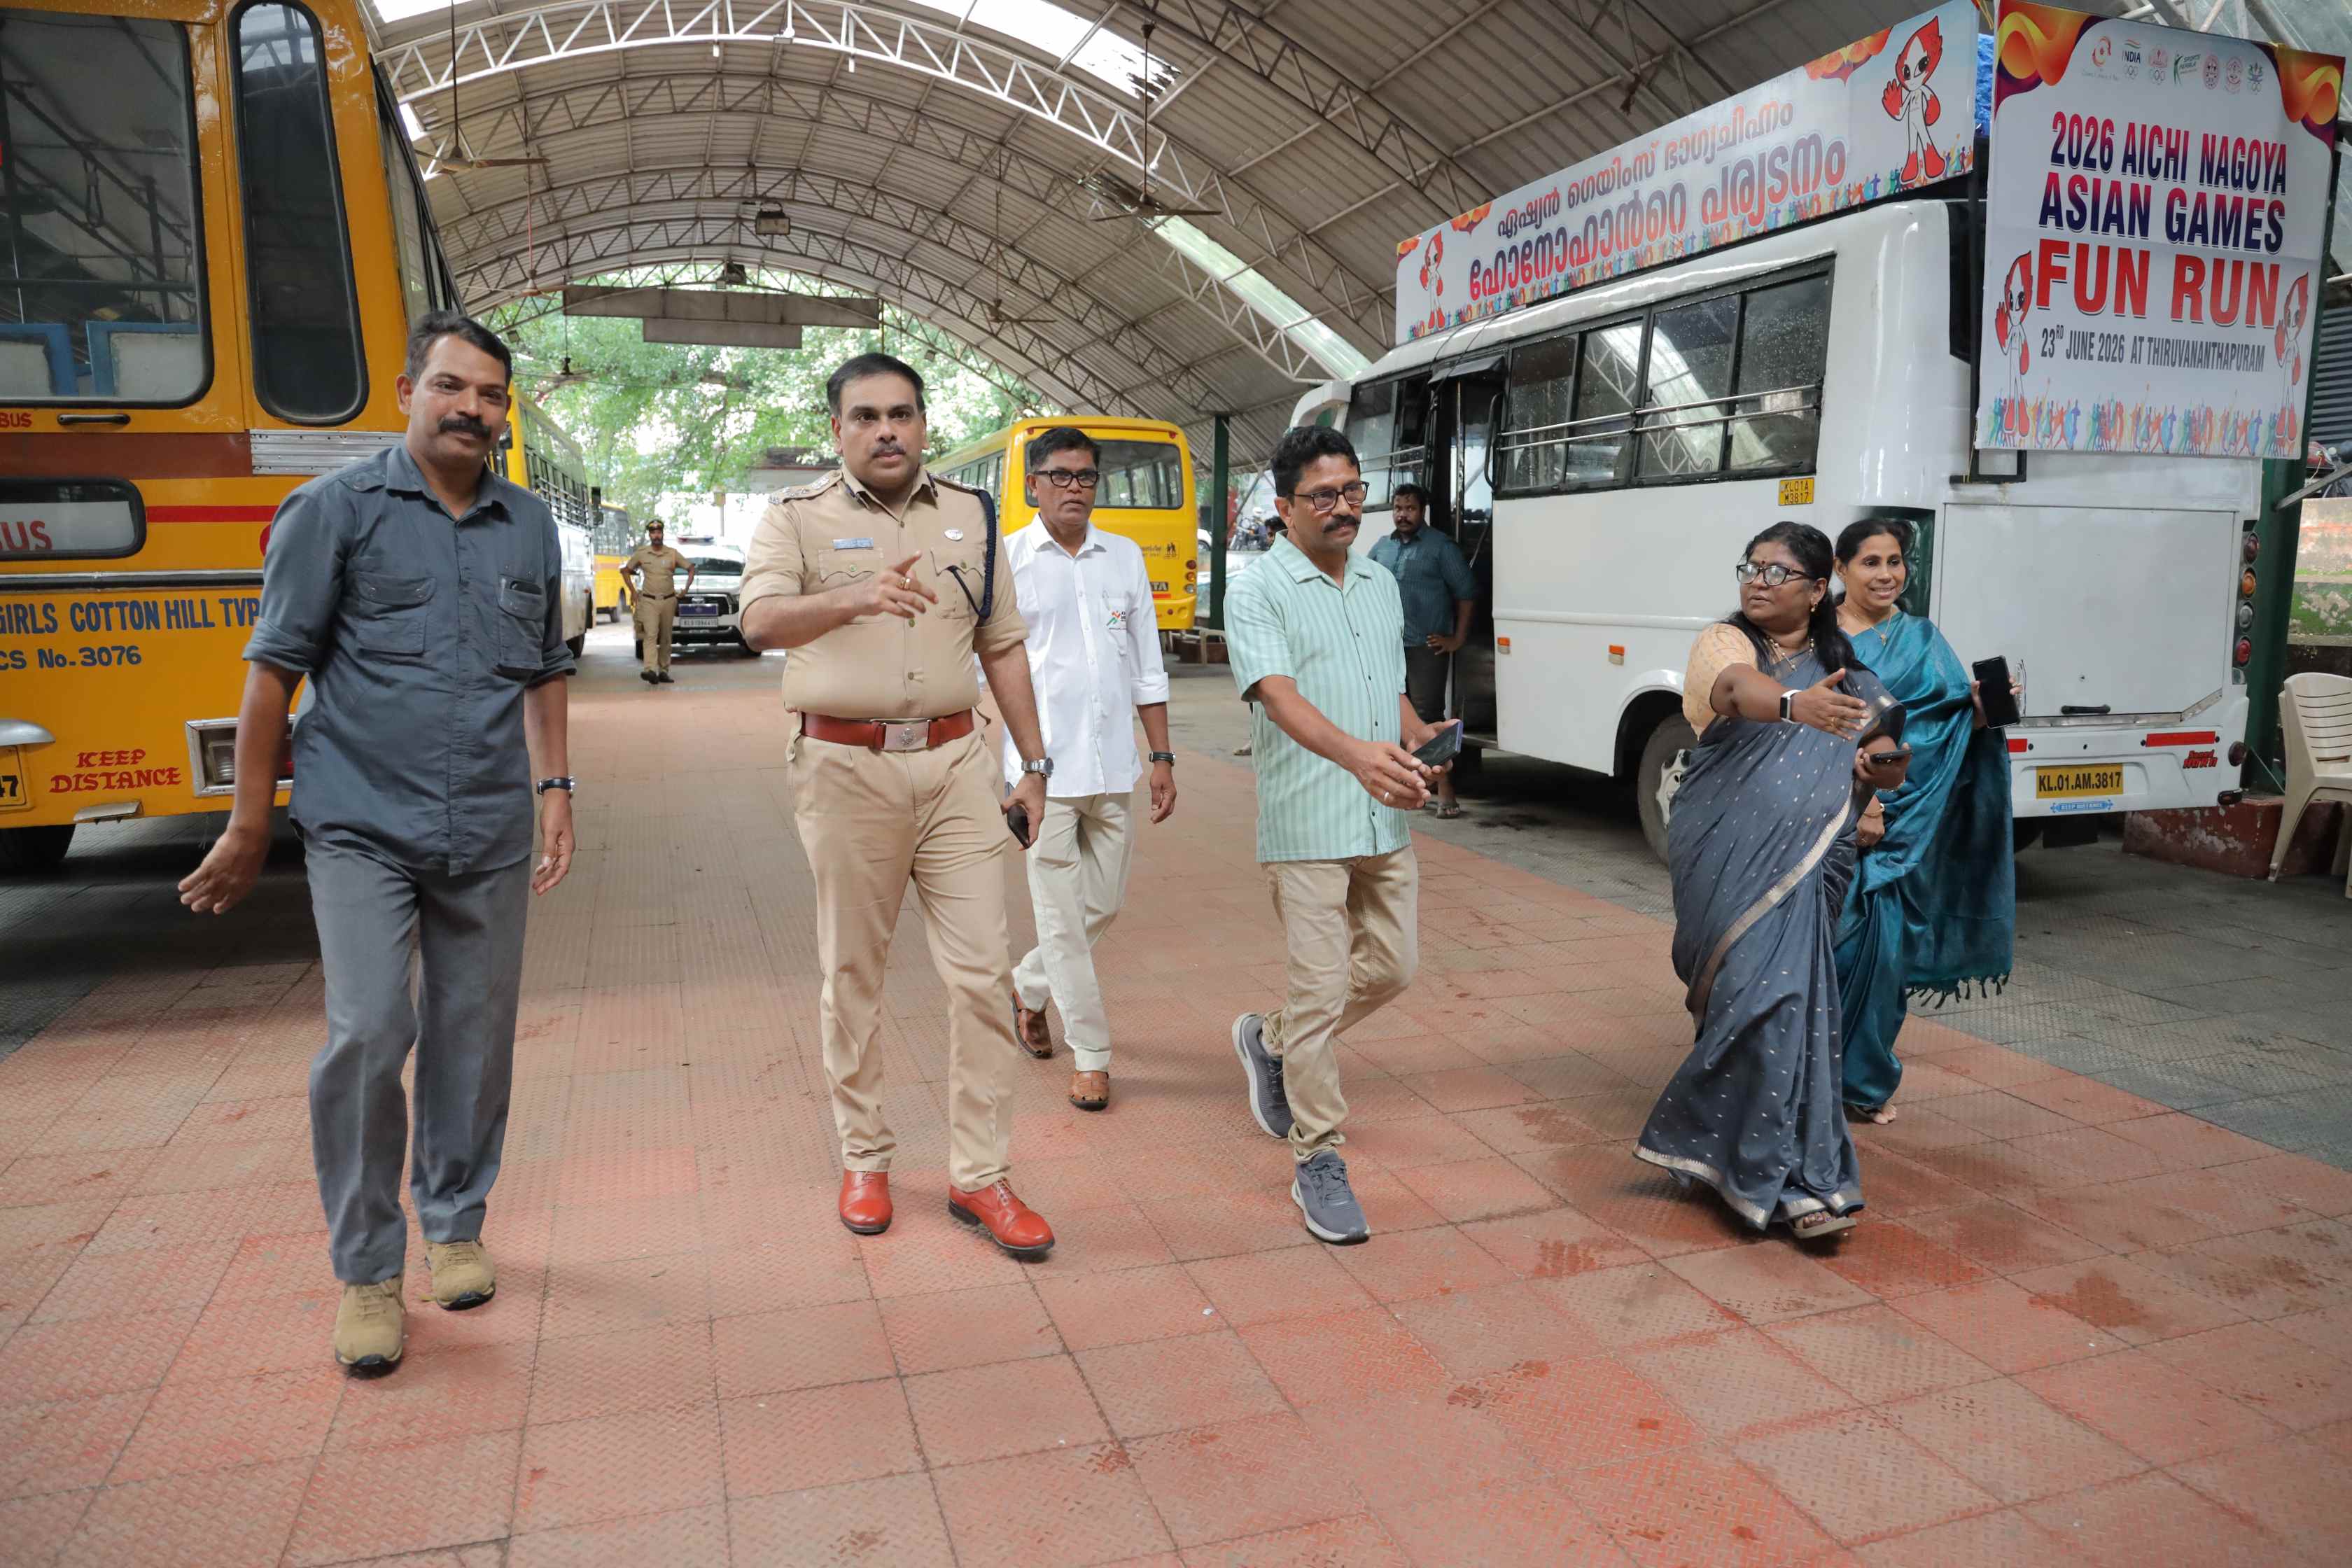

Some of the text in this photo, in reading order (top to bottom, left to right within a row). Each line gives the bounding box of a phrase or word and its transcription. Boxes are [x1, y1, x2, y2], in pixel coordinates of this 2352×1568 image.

[2122, 50, 2141, 64] INDIA
[2050, 111, 2287, 196] 2026 AICHI NAGOYA
[1498, 187, 1561, 239] ഏഷ്യൻ
[1568, 140, 1660, 209] ഗെയിംസ്
[1701, 133, 1846, 227] പര്യടനം
[2038, 172, 2286, 255] ASIAN GAMES
[2036, 239, 2281, 330] FUN RUN
[2066, 330, 2095, 361] JUNE
[2097, 332, 2125, 363] 2026
[2130, 335, 2145, 365] AT
[2147, 337, 2266, 372] THIRUVANANTHAPURAM
[0, 412, 32, 428] BUS
[1785, 480, 1809, 492] KL01A
[0, 520, 52, 552] US
[70, 600, 160, 632] COTTON
[164, 598, 216, 629] HILL
[76, 749, 146, 768] KEEP
[50, 767, 182, 794] DISTANCE
